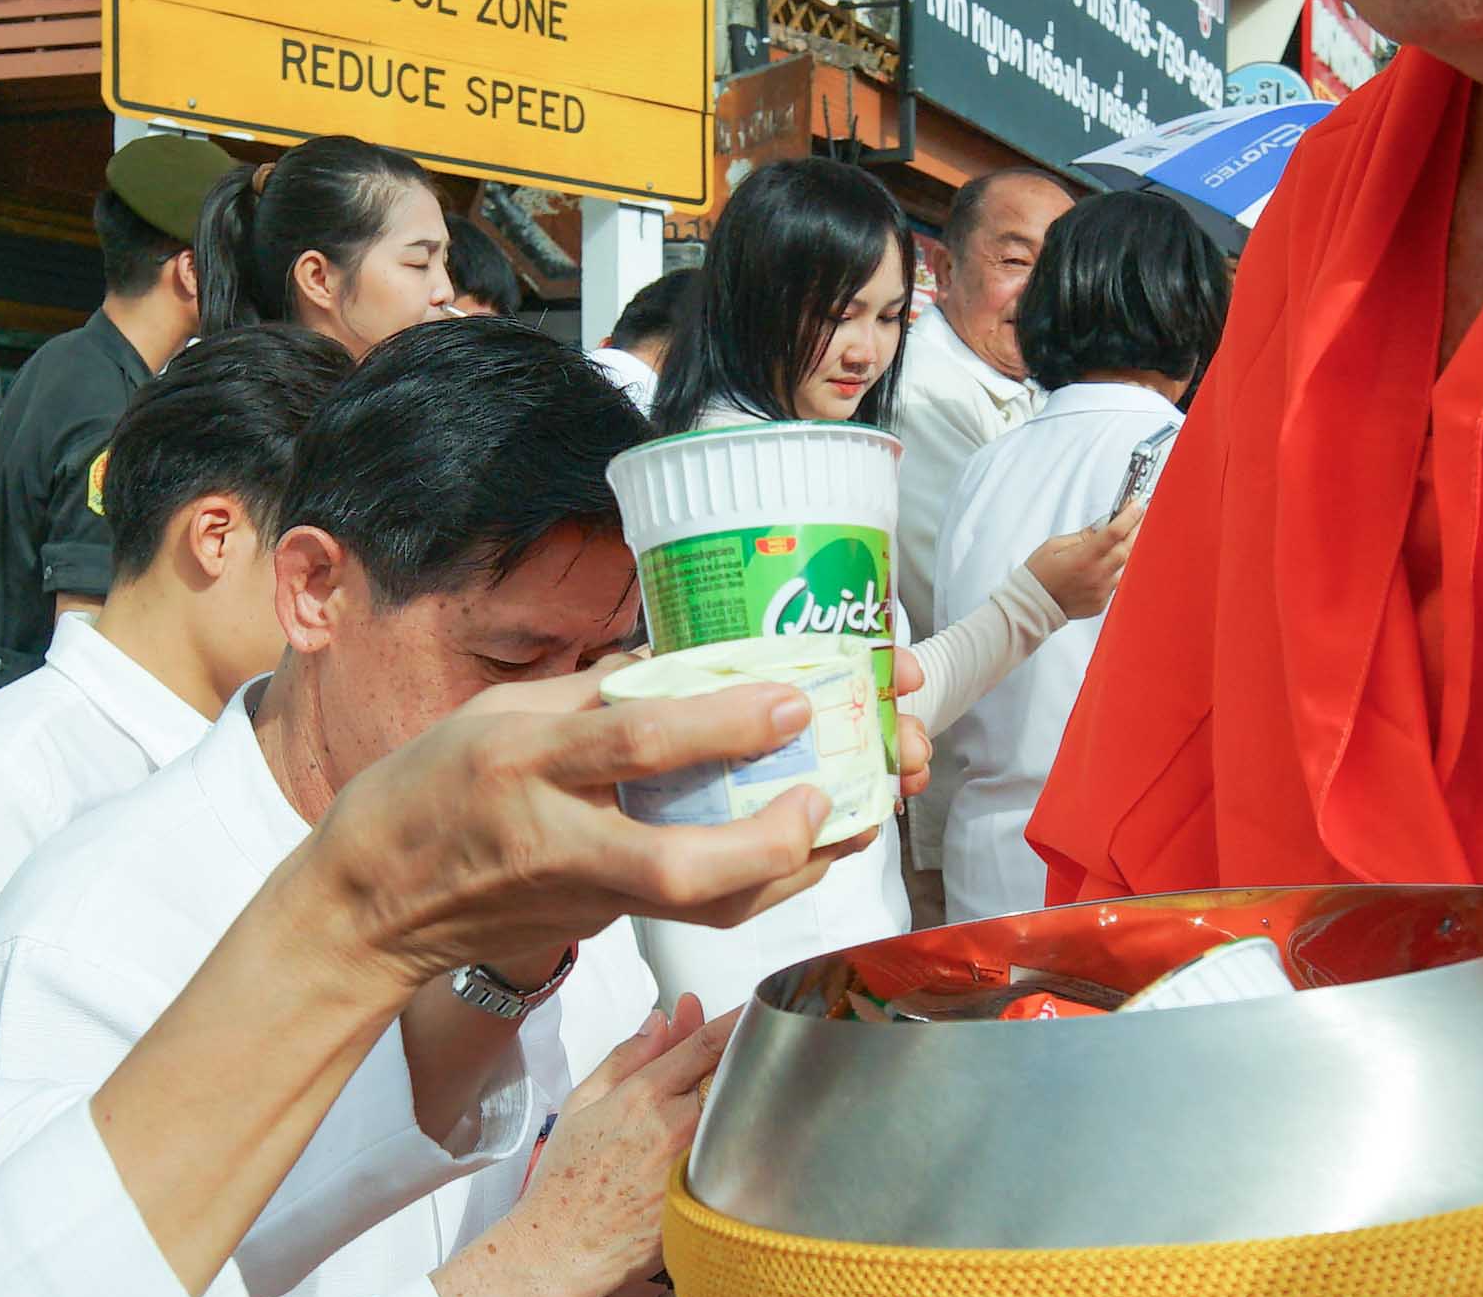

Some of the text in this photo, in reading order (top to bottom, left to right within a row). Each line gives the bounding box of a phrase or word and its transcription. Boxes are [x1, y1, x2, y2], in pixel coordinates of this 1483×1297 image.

[282, 38, 585, 136] REDUCE SPEED
[1026, 20, 1098, 133] เครื่องปรุง
[763, 576, 884, 637] Quick
